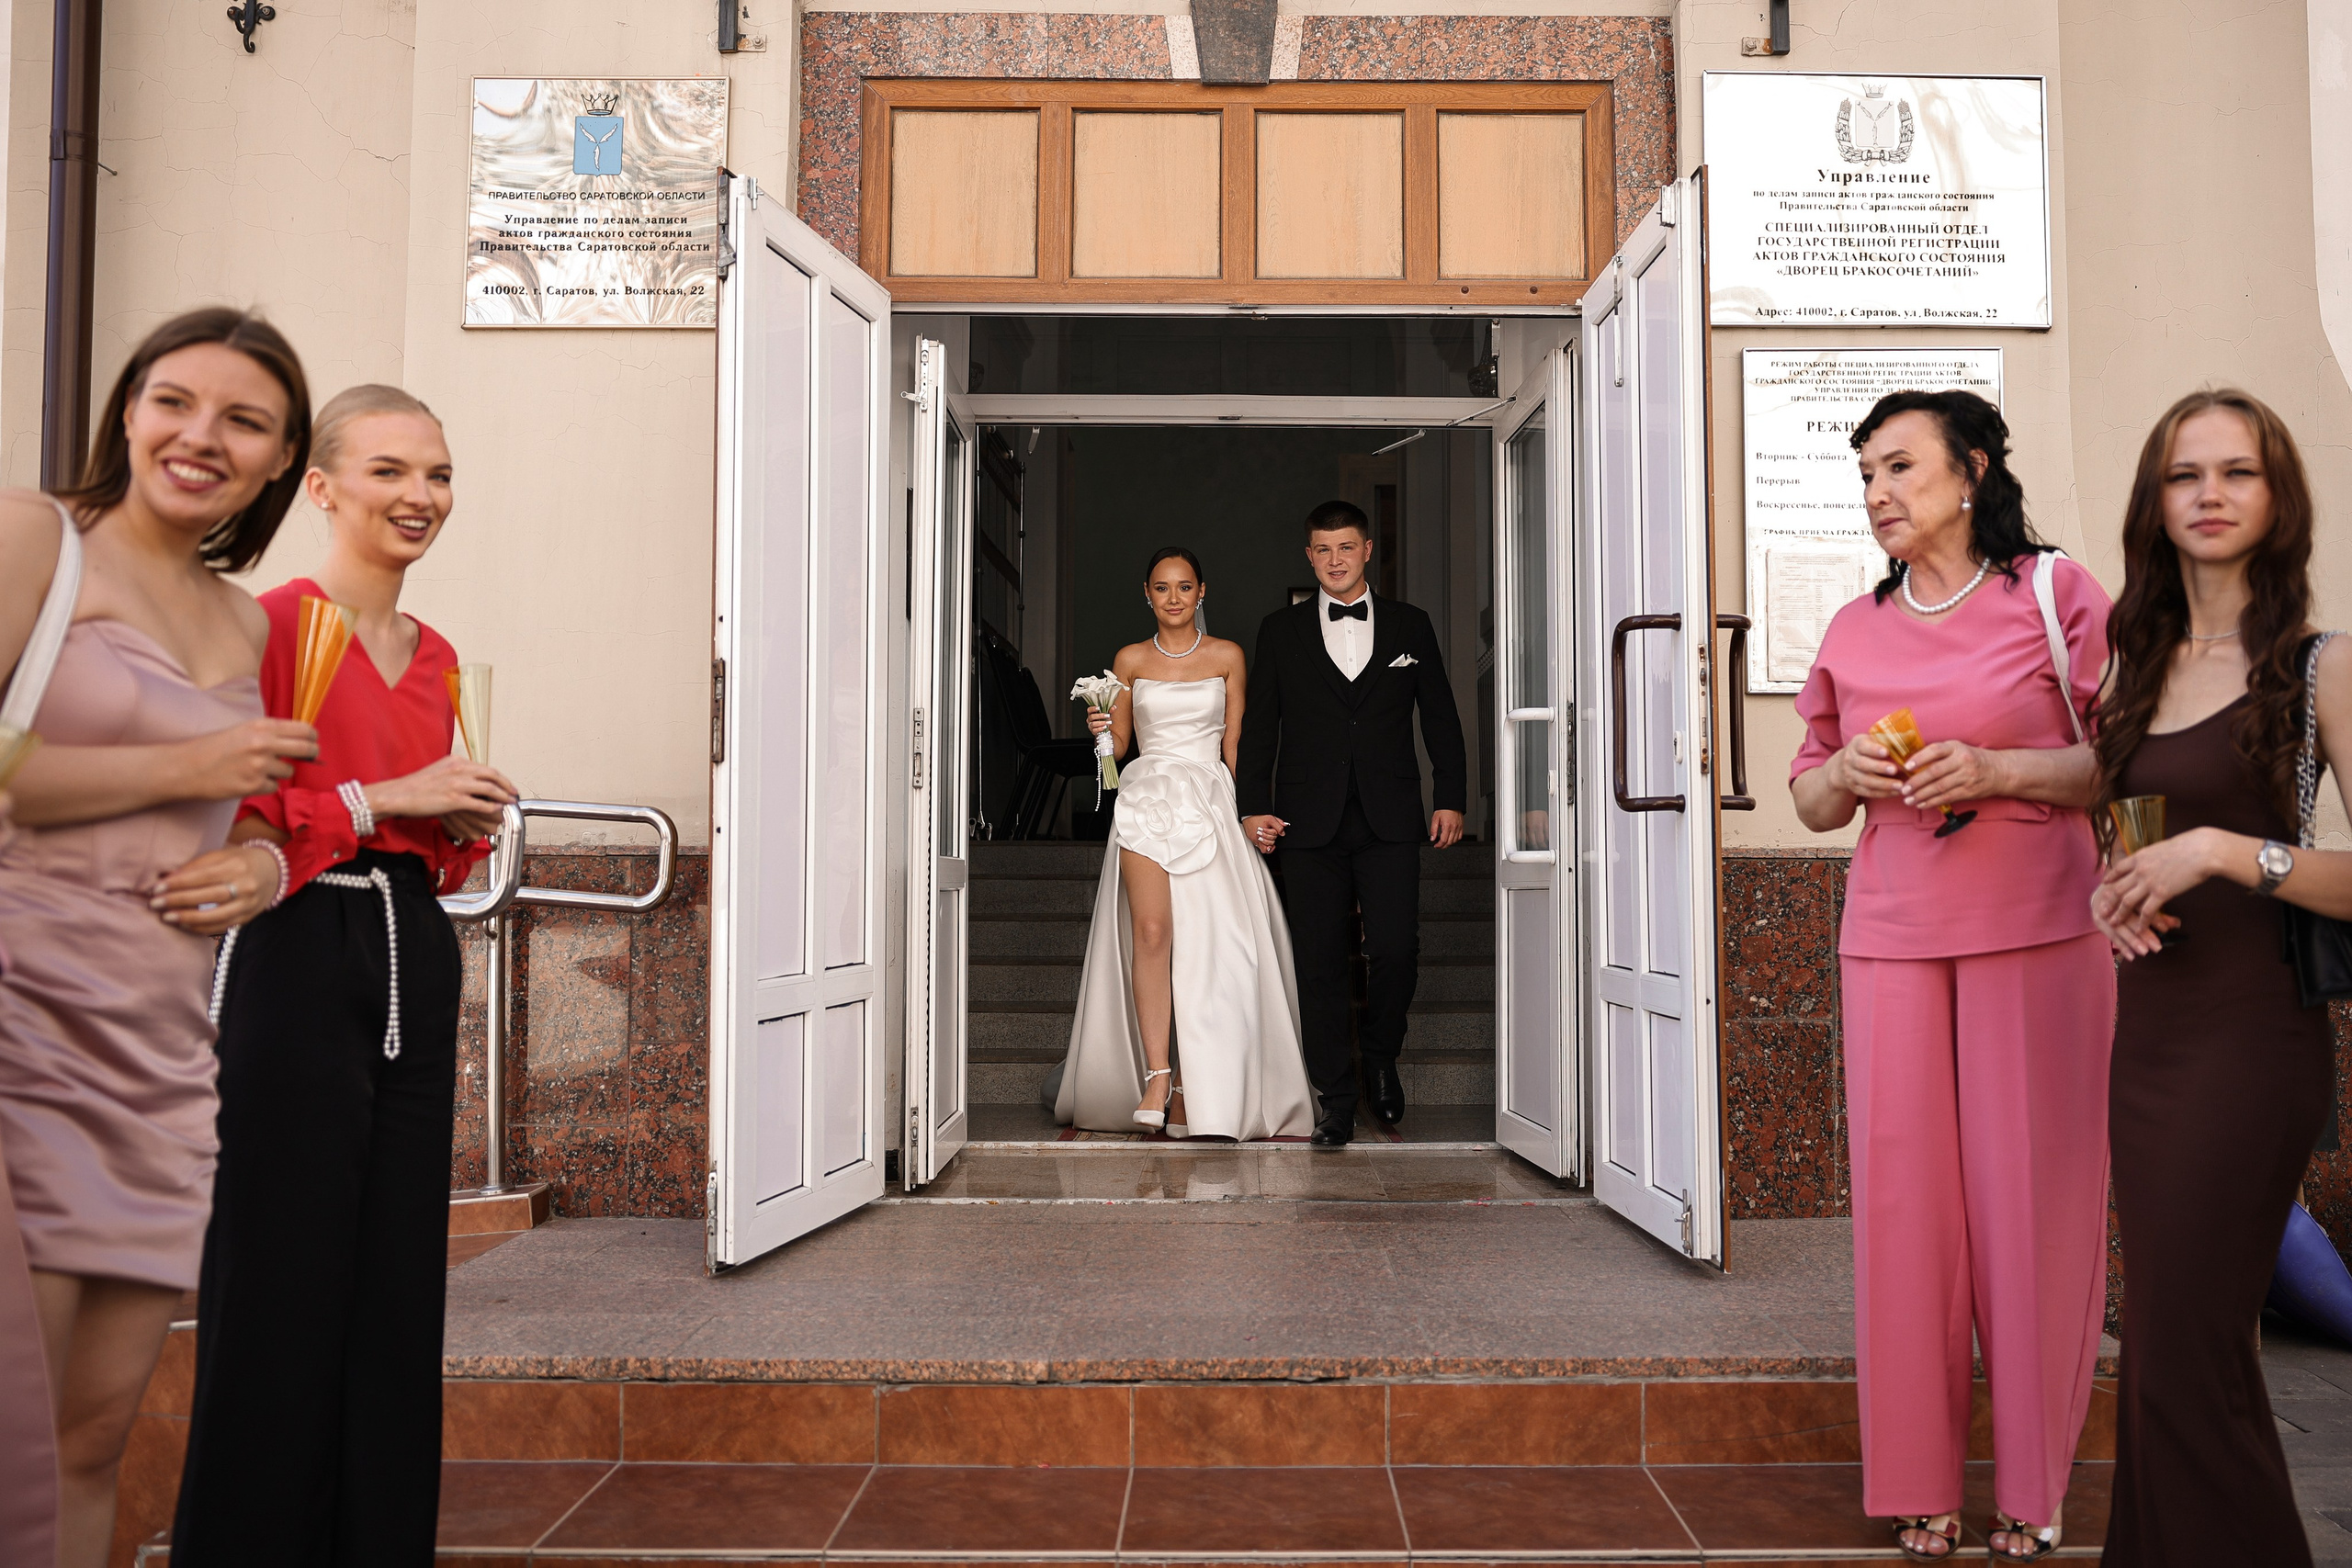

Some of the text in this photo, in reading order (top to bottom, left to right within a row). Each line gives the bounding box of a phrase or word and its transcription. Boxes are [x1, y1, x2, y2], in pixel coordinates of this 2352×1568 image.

[1817, 169, 1930, 186] Управление
[488, 190, 706, 200] ПРАВИТЕЛЬСТВО САРАТОВСКОЙ ОБЛАСТИ
[1870, 192, 1940, 200] гражданского
[1943, 192, 1995, 200] состояния
[1780, 201, 1969, 212] Правительства Саратовской области
[504, 214, 579, 226] Управление
[602, 217, 639, 225] делам
[1765, 221, 1988, 234] СПЕЦИАЛИЗИРОВАННЫЙ ОТДЕЛ
[498, 230, 692, 240] актов гражданского состояния
[480, 241, 710, 254] Правительства Саратовской области
[1758, 236, 2000, 249] ГОСУДАРСТВЕННОЙ РЕГИСТРАЦИИ
[1752, 251, 2006, 263] АКТОВ ГРАЖДАНСКОГО СОСТОЯНИЯ
[1777, 265, 1979, 276] «ДВОРЕЦ БРАКОСОЧЕТАНИЙ»
[482, 286, 705, 297] 410002, г. Саратов, ул. Волжская, 22
[1755, 307, 1997, 319] Адрес: 410002, г. Саратов, ул. Волжская, 22
[1789, 368, 1871, 377] ГОСУДАРСТВЕННОЙ
[1806, 421, 1863, 433] РЕЖИ
[1756, 452, 1798, 462] Вторник
[1807, 452, 1847, 463] Суббота
[1756, 476, 1801, 486] Перерыв
